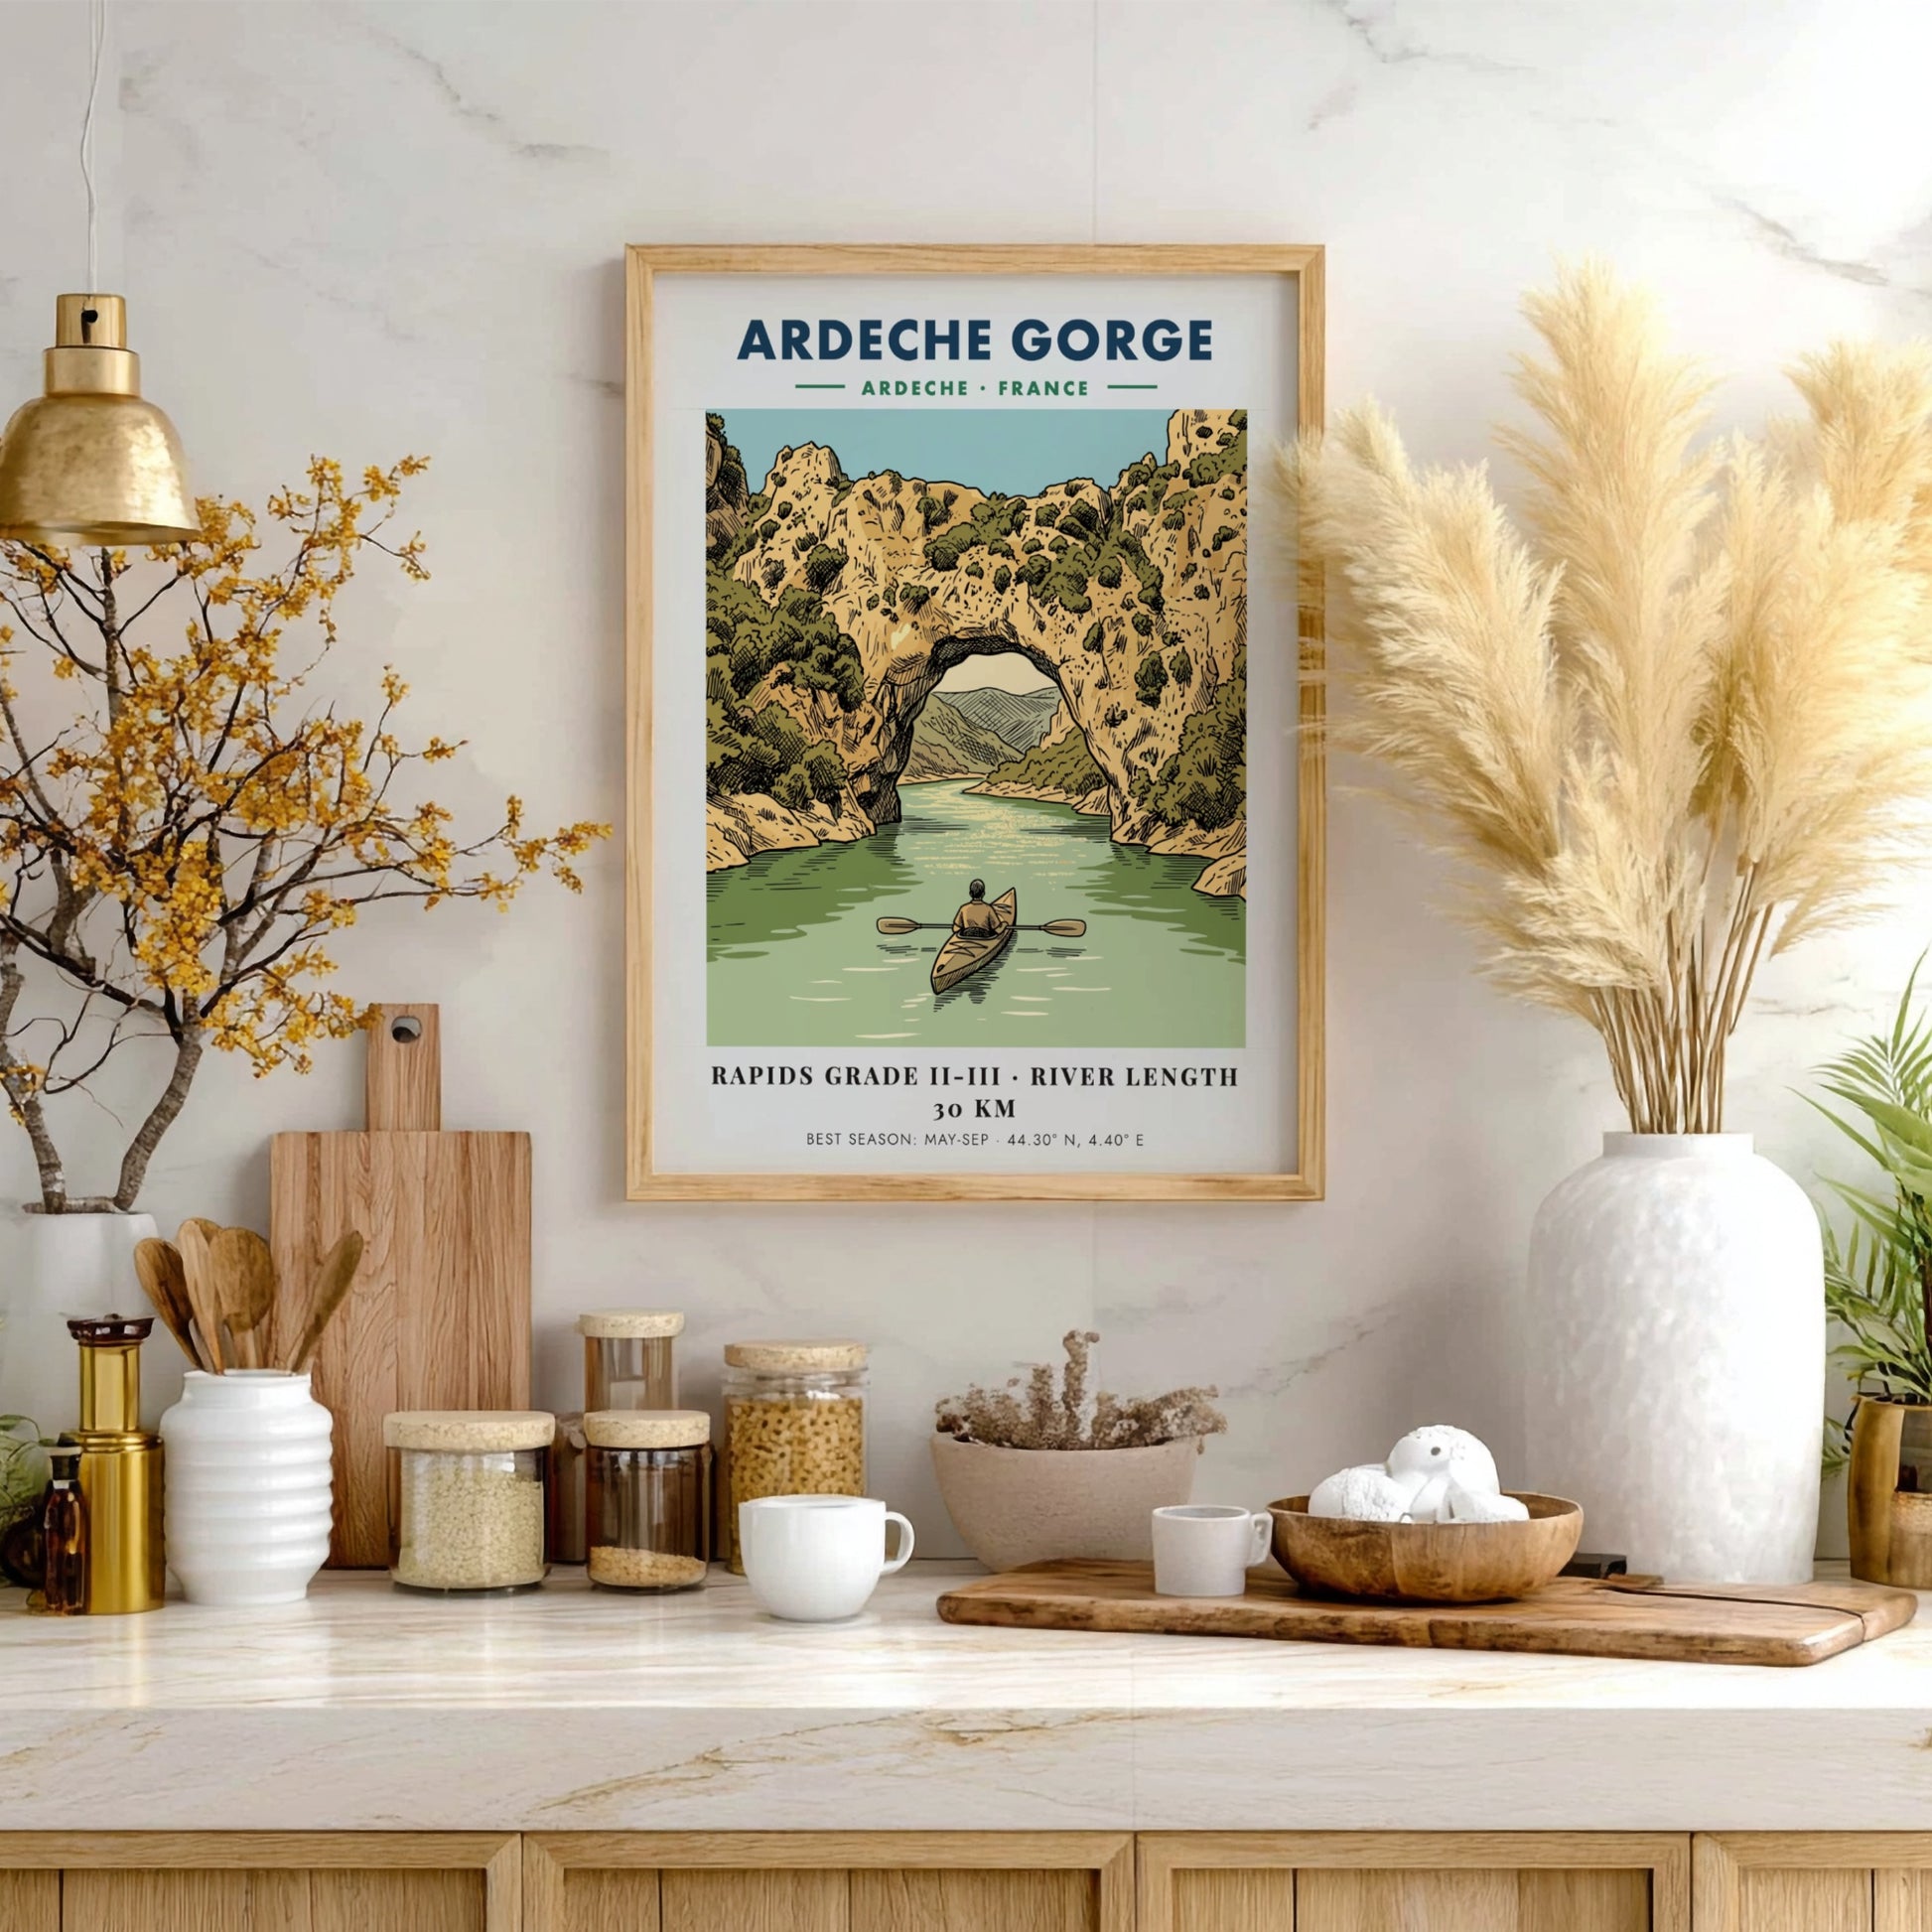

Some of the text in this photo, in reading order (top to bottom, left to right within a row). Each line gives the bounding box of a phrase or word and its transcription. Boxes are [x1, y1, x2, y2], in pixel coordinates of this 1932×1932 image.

[737, 319, 1212, 361] ARDECHE GORGE
[862, 380, 967, 396] ARDECHE
[999, 380, 1088, 396] FRANCE
[712, 1065, 813, 1086] RAPIDS
[825, 1065, 918, 1086] GRADE
[929, 1066, 1001, 1086] II-III
[1030, 1066, 1116, 1087] RIVER
[1126, 1066, 1239, 1087] LENGTH
[933, 1099, 1016, 1122] 30 KM
[806, 1133, 842, 1146] BEST
[848, 1133, 917, 1146] SEASON:
[924, 1133, 989, 1146] MAY-SEP
[1007, 1133, 1057, 1147] 44.30°
[1064, 1134, 1081, 1149] N,
[1088, 1133, 1130, 1147] 4.40°
[1136, 1134, 1145, 1147] E
